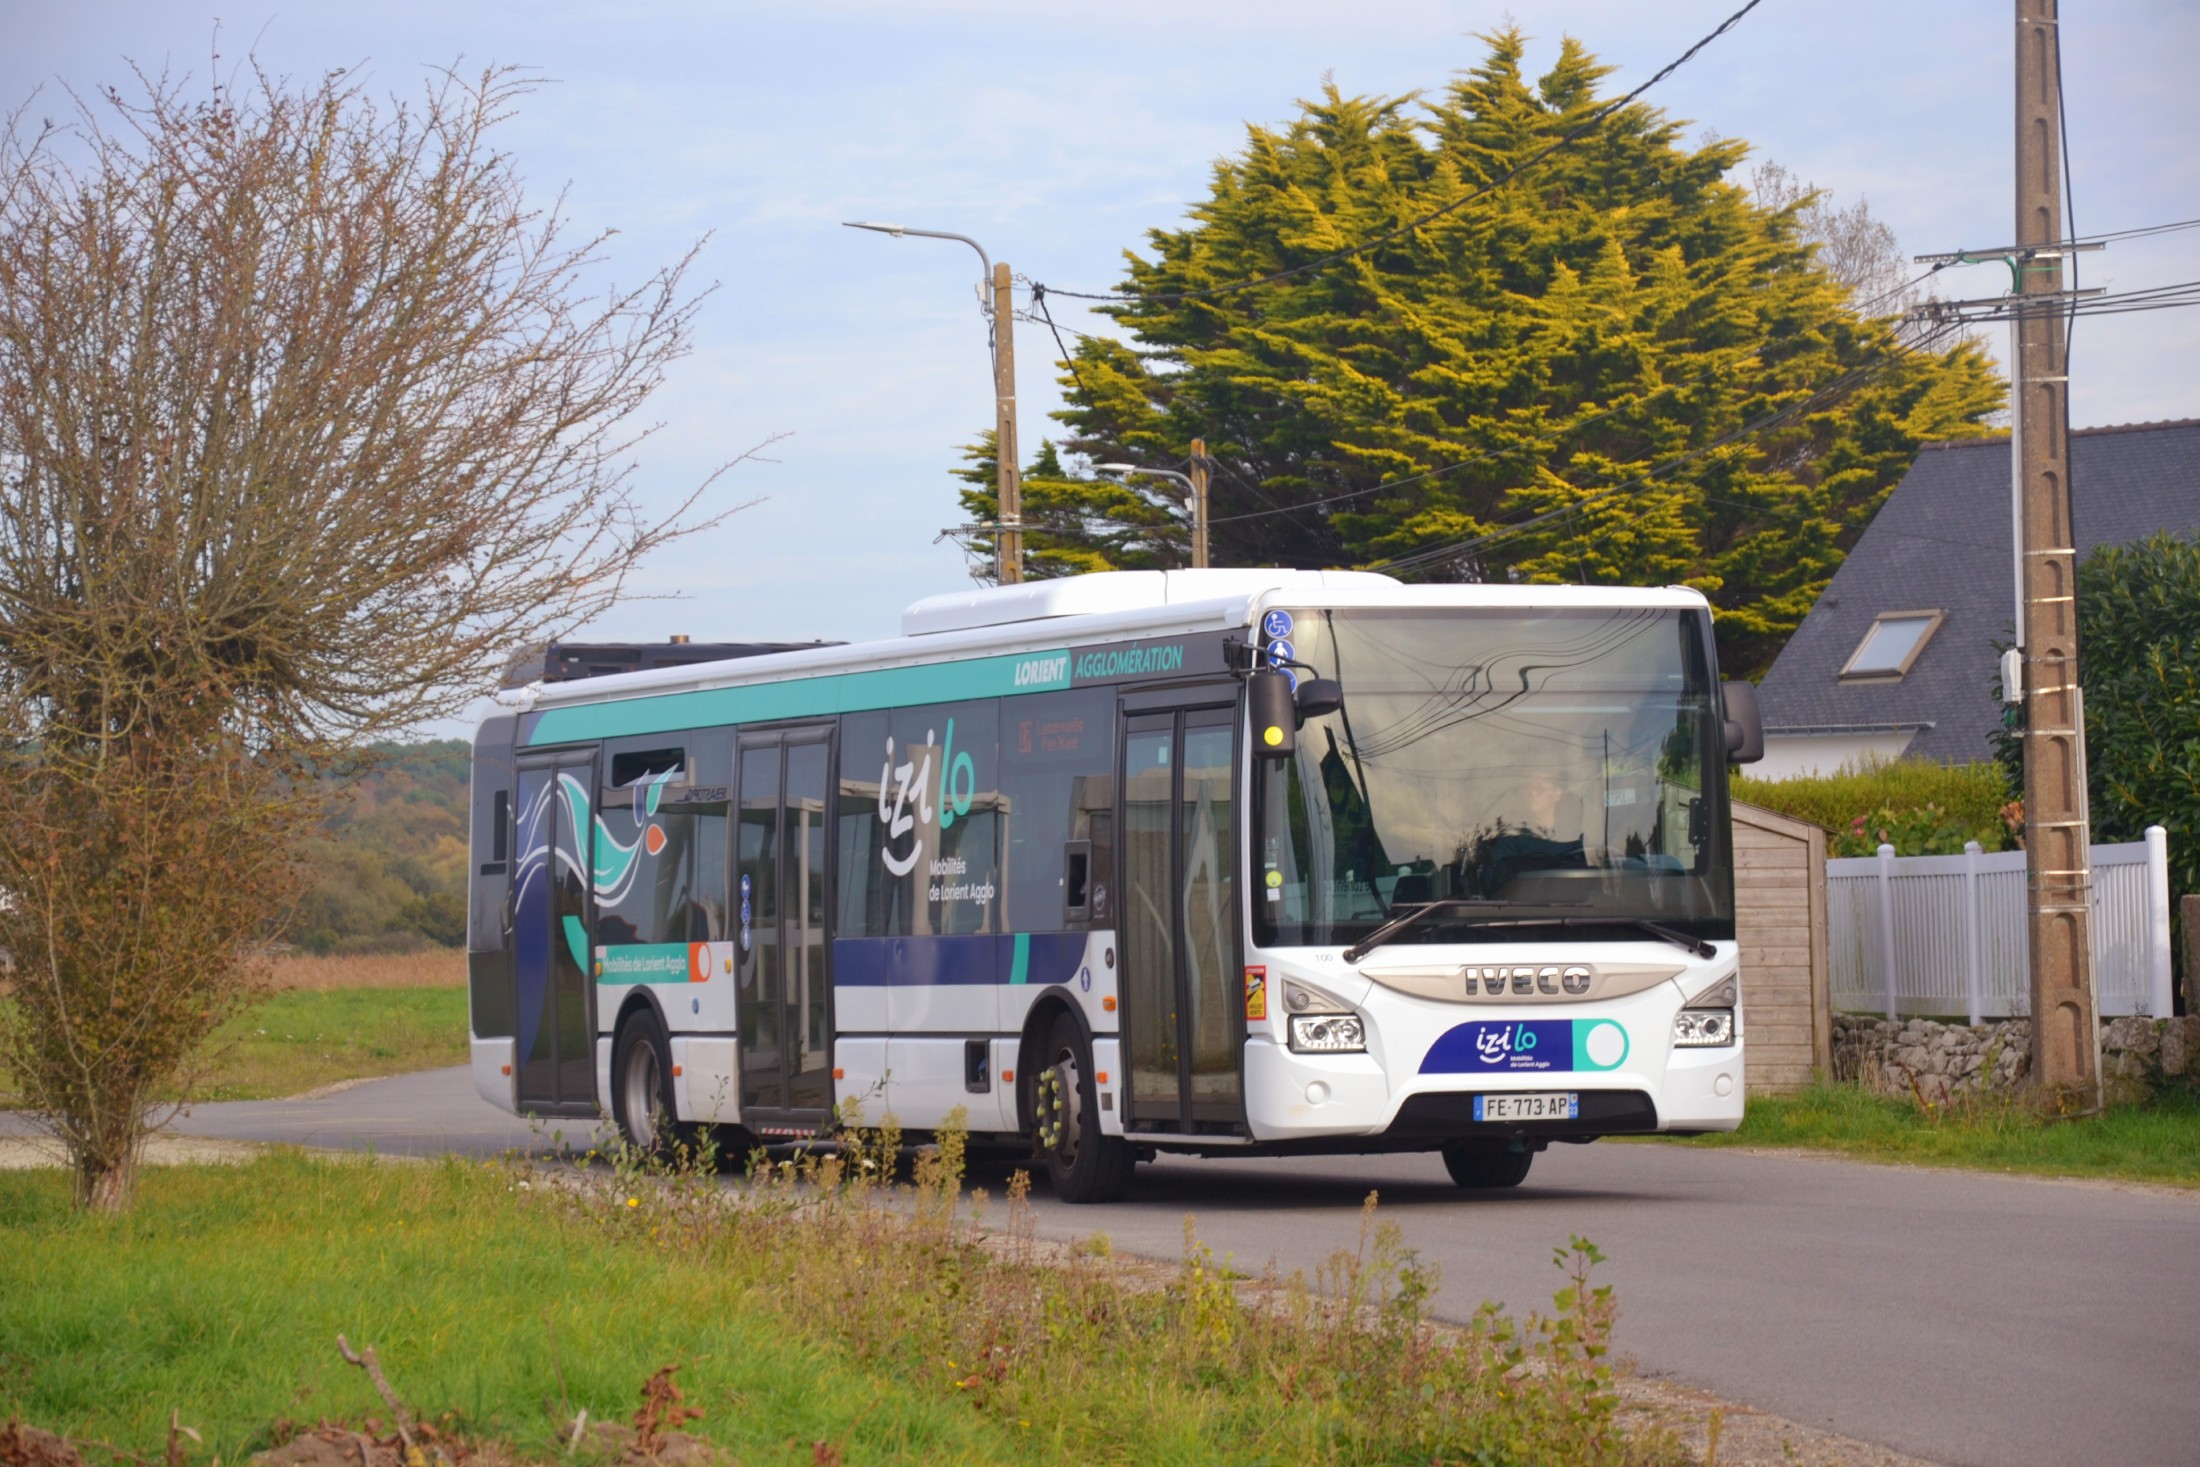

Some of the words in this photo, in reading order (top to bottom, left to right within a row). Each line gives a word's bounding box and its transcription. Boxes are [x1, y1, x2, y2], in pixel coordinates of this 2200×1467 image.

[1015, 656, 1067, 686] LORIENT
[1075, 642, 1183, 678] AGGLOMÉRATION
[930, 857, 966, 875] Mobilités
[929, 884, 940, 901] de
[941, 882, 969, 900] Lorient
[970, 882, 995, 905] Agglo
[603, 955, 632, 973] Mobilités
[633, 956, 641, 972] de
[642, 955, 665, 972] Lorient
[666, 954, 686, 975] Agglo
[1315, 954, 1333, 962] 100
[1466, 967, 1590, 995] IVECO
[1476, 1023, 1537, 1054] izilo
